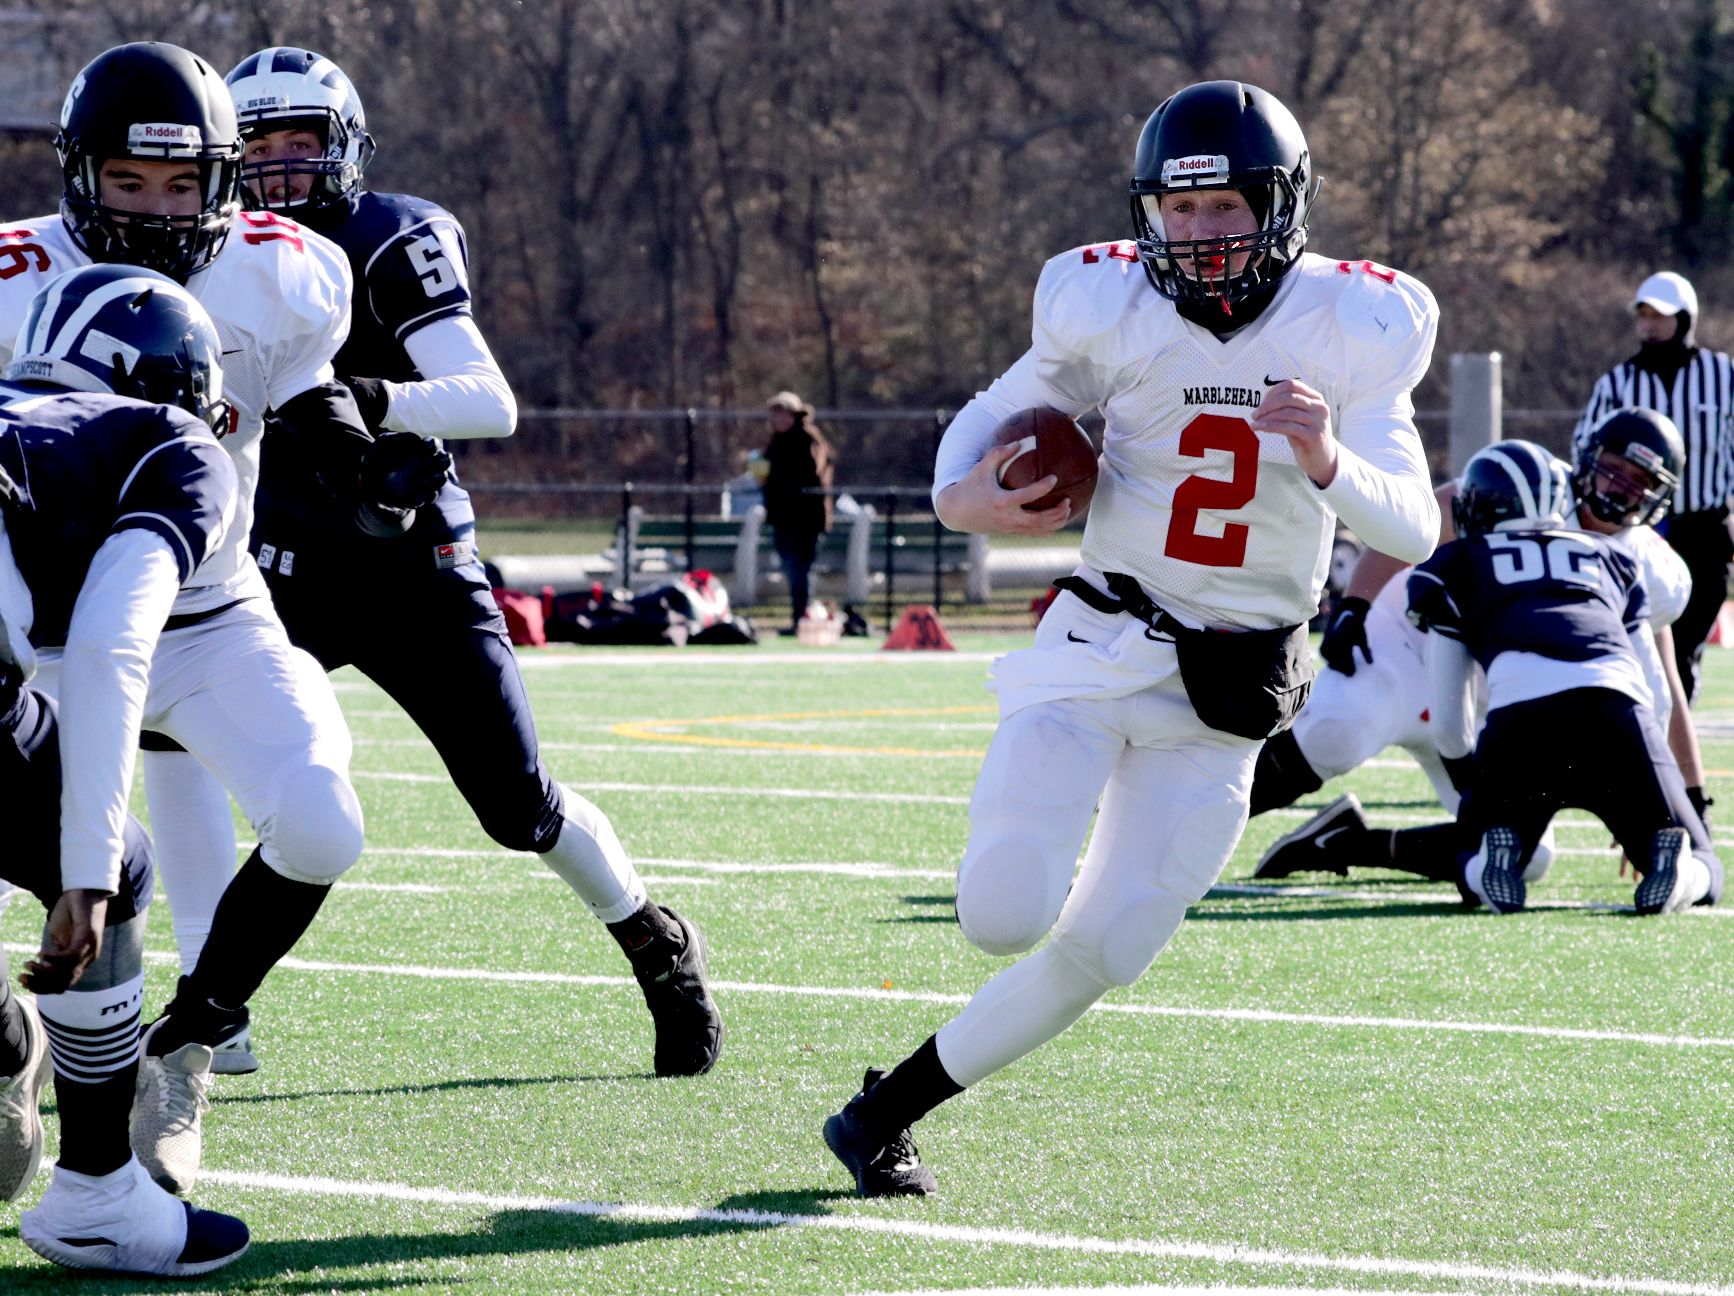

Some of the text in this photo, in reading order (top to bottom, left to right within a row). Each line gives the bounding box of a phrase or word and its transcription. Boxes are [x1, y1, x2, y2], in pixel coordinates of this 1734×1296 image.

[247, 96, 277, 109] BIG BLUE
[144, 126, 184, 138] Riddell
[1178, 157, 1215, 171] Riddell
[1182, 386, 1262, 408] MARBLEHEAD
[1164, 412, 1261, 568] 2
